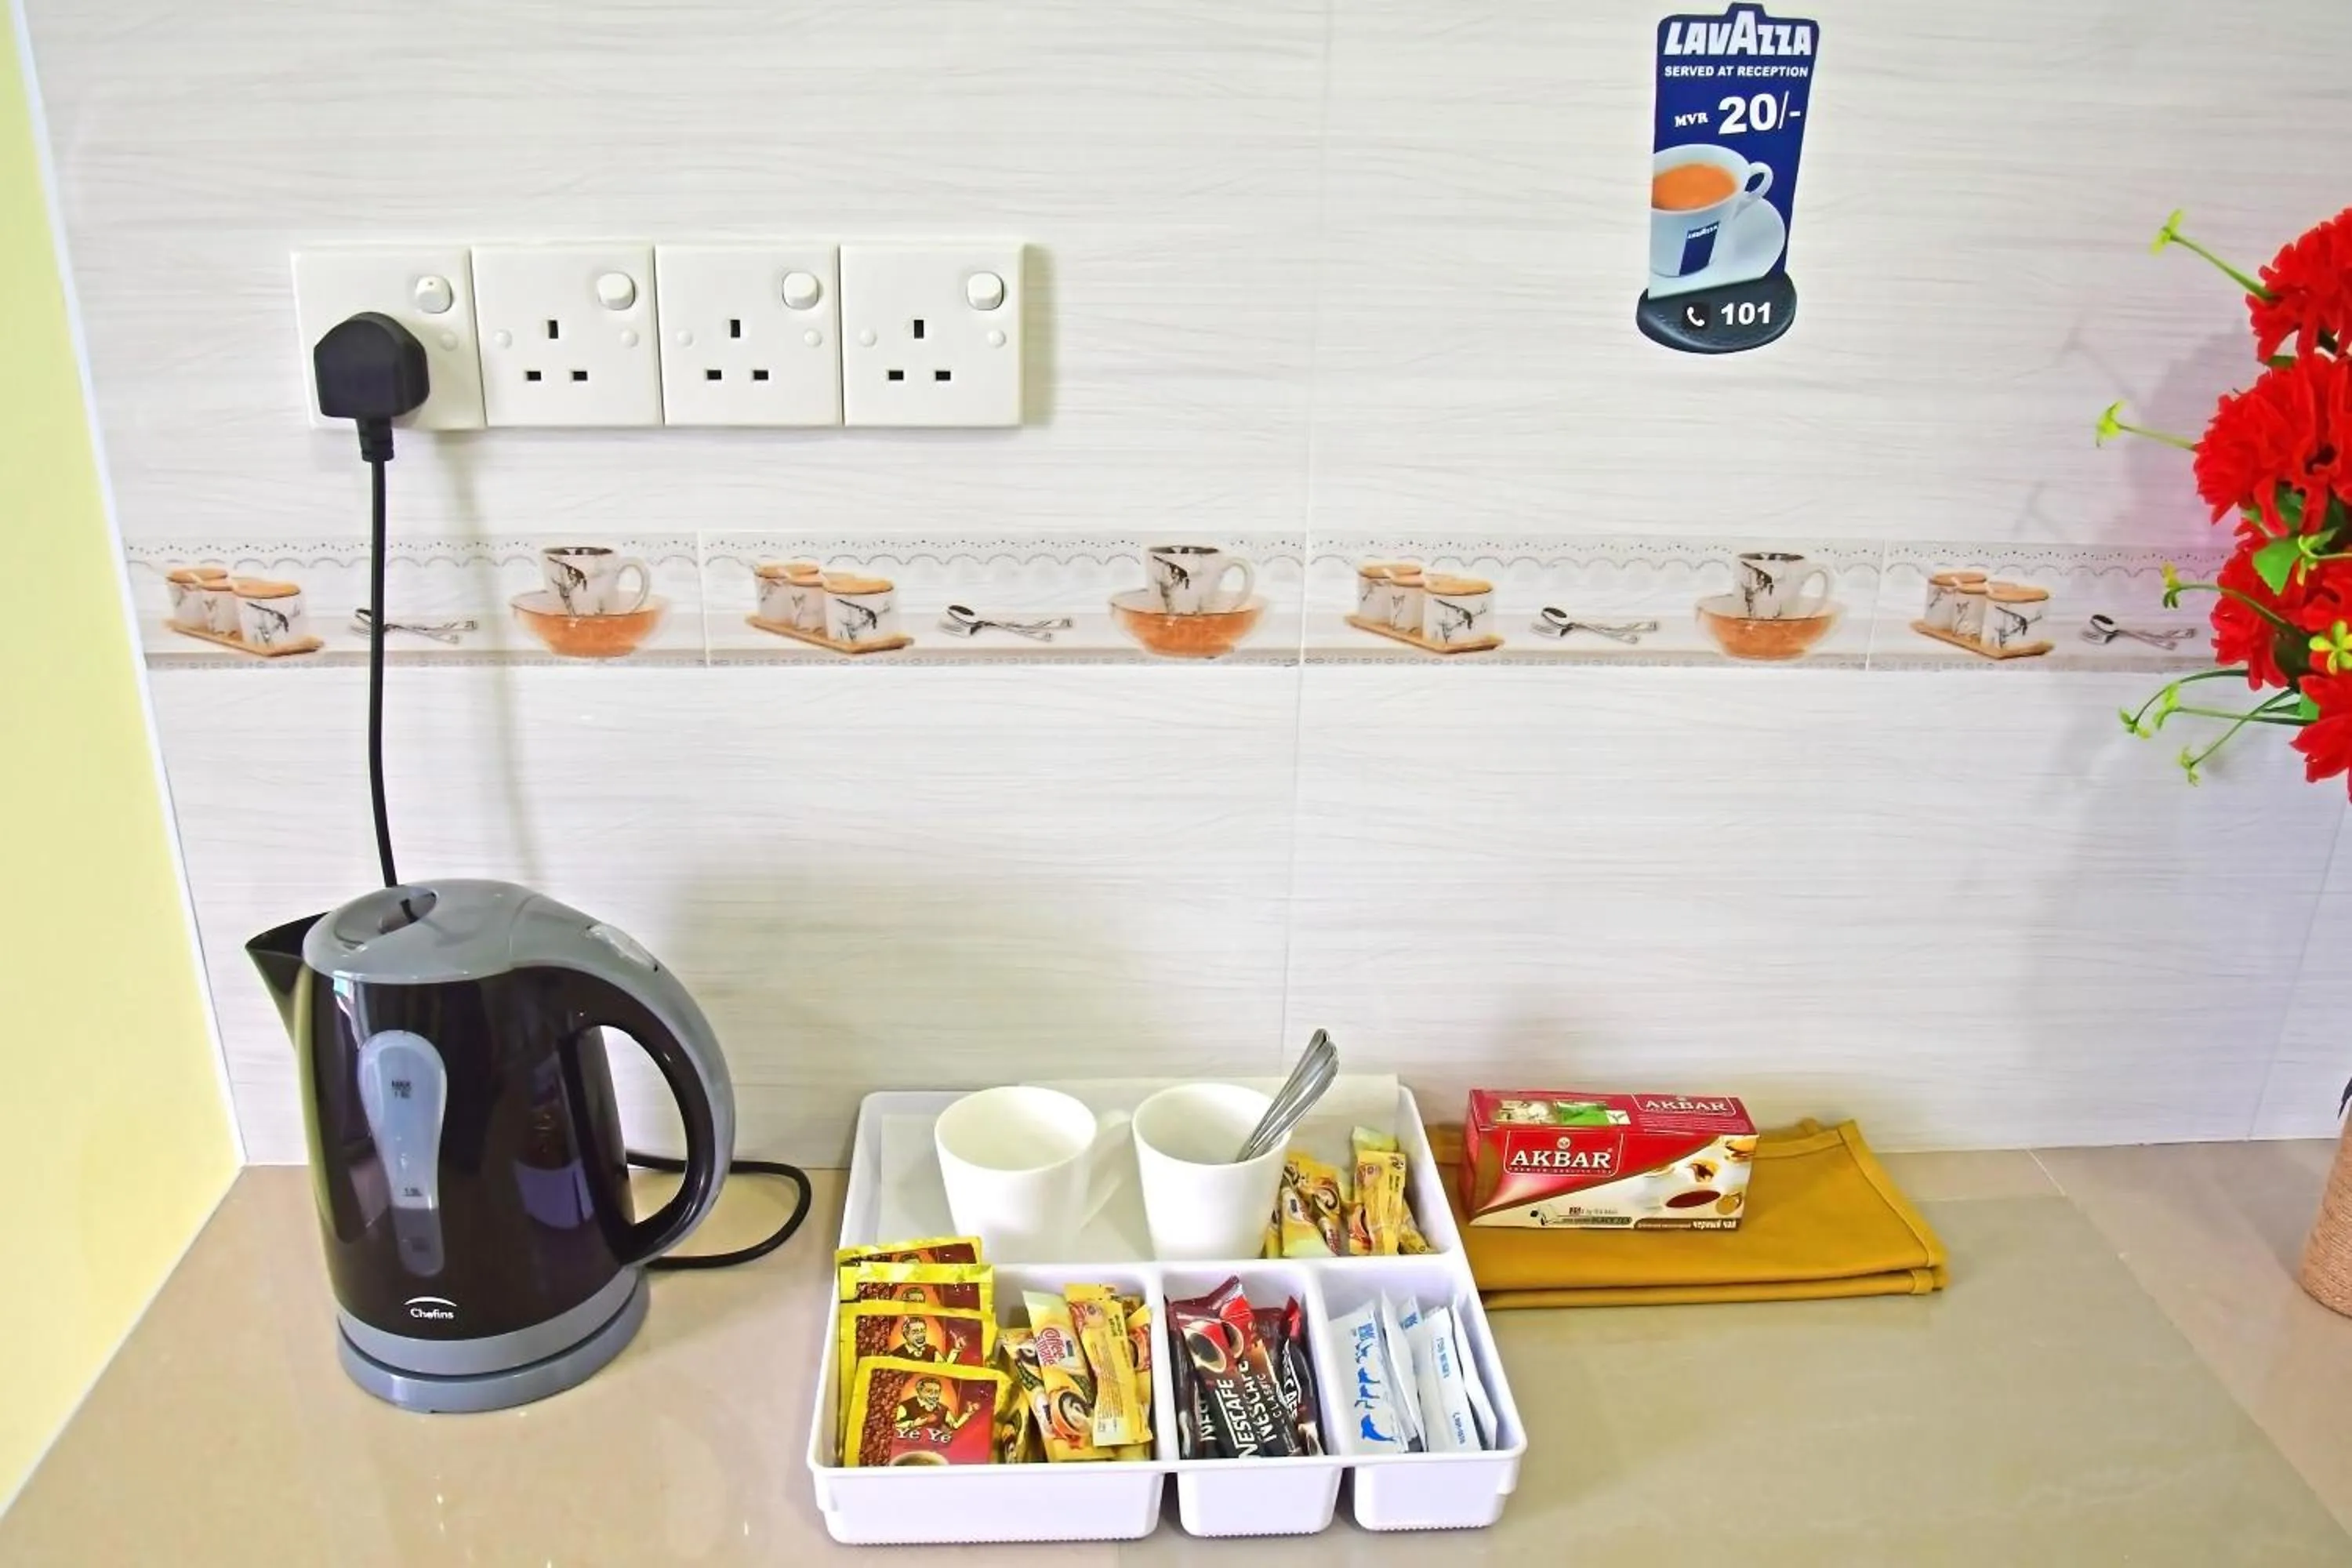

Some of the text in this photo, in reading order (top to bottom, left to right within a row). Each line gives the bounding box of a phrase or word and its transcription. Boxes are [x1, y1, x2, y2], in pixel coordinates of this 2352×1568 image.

[1664, 10, 1812, 56] LAVAZZA
[1664, 65, 1809, 78] SERVED AT RECEPTION
[1675, 91, 1802, 135] MVR 20/-
[1721, 302, 1772, 325] 101
[1646, 1099, 1726, 1111] AKBAR
[1511, 1149, 1612, 1169] AKBAR
